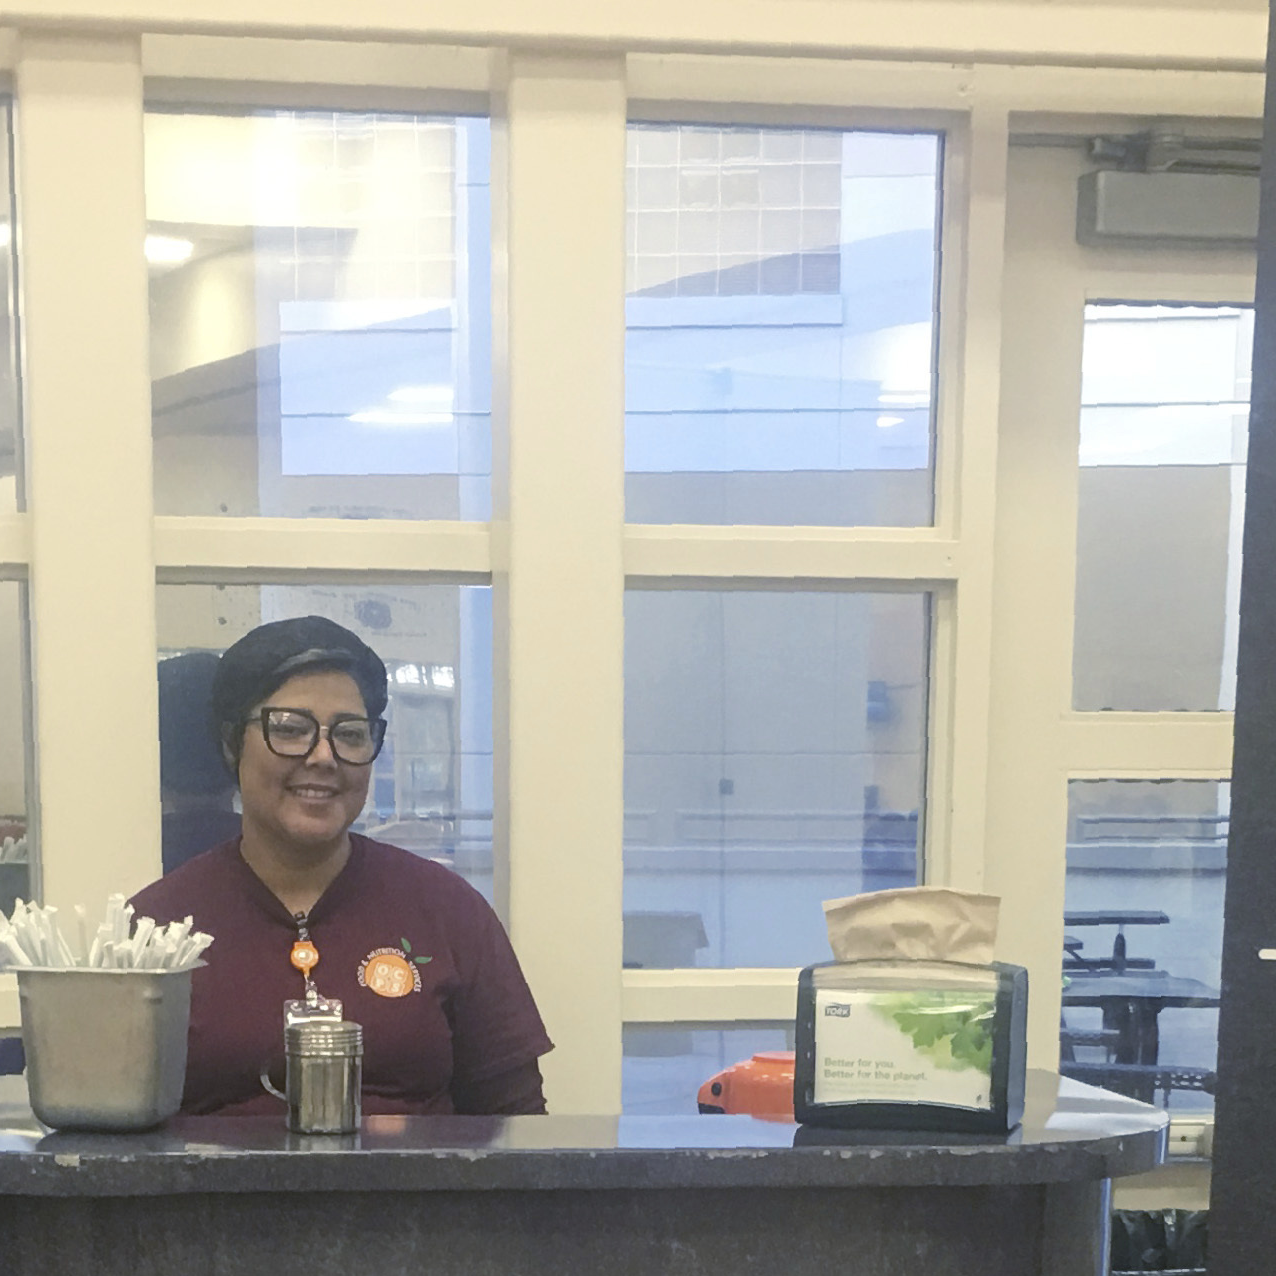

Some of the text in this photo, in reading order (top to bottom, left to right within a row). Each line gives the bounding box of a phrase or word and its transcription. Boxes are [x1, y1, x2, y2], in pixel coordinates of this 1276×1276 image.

[824, 1057, 854, 1068] Better
[858, 1058, 871, 1067] for
[824, 1069, 854, 1079] Better
[875, 1071, 890, 1080] the
